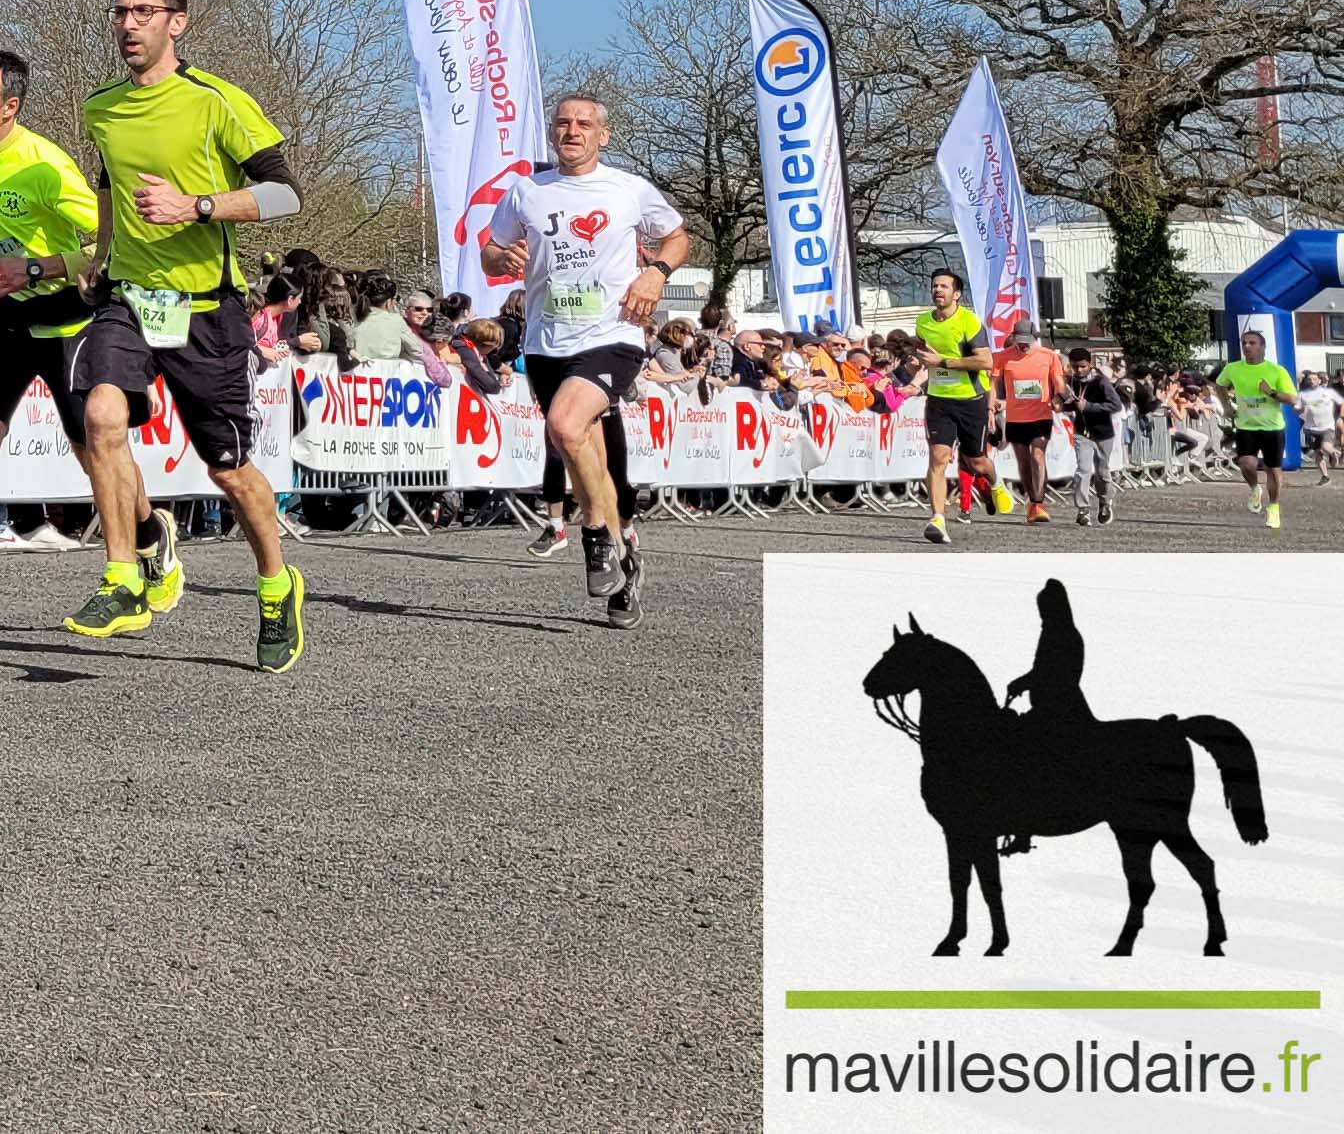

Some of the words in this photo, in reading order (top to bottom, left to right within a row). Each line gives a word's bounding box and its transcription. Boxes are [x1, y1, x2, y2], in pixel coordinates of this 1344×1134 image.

[552, 241, 570, 251] La
[555, 248, 596, 264] Roche
[572, 260, 589, 269] Yon
[553, 296, 583, 307] 1808
[320, 373, 442, 428] INTERSPORT
[323, 441, 337, 454] LA
[381, 442, 399, 456] SUR
